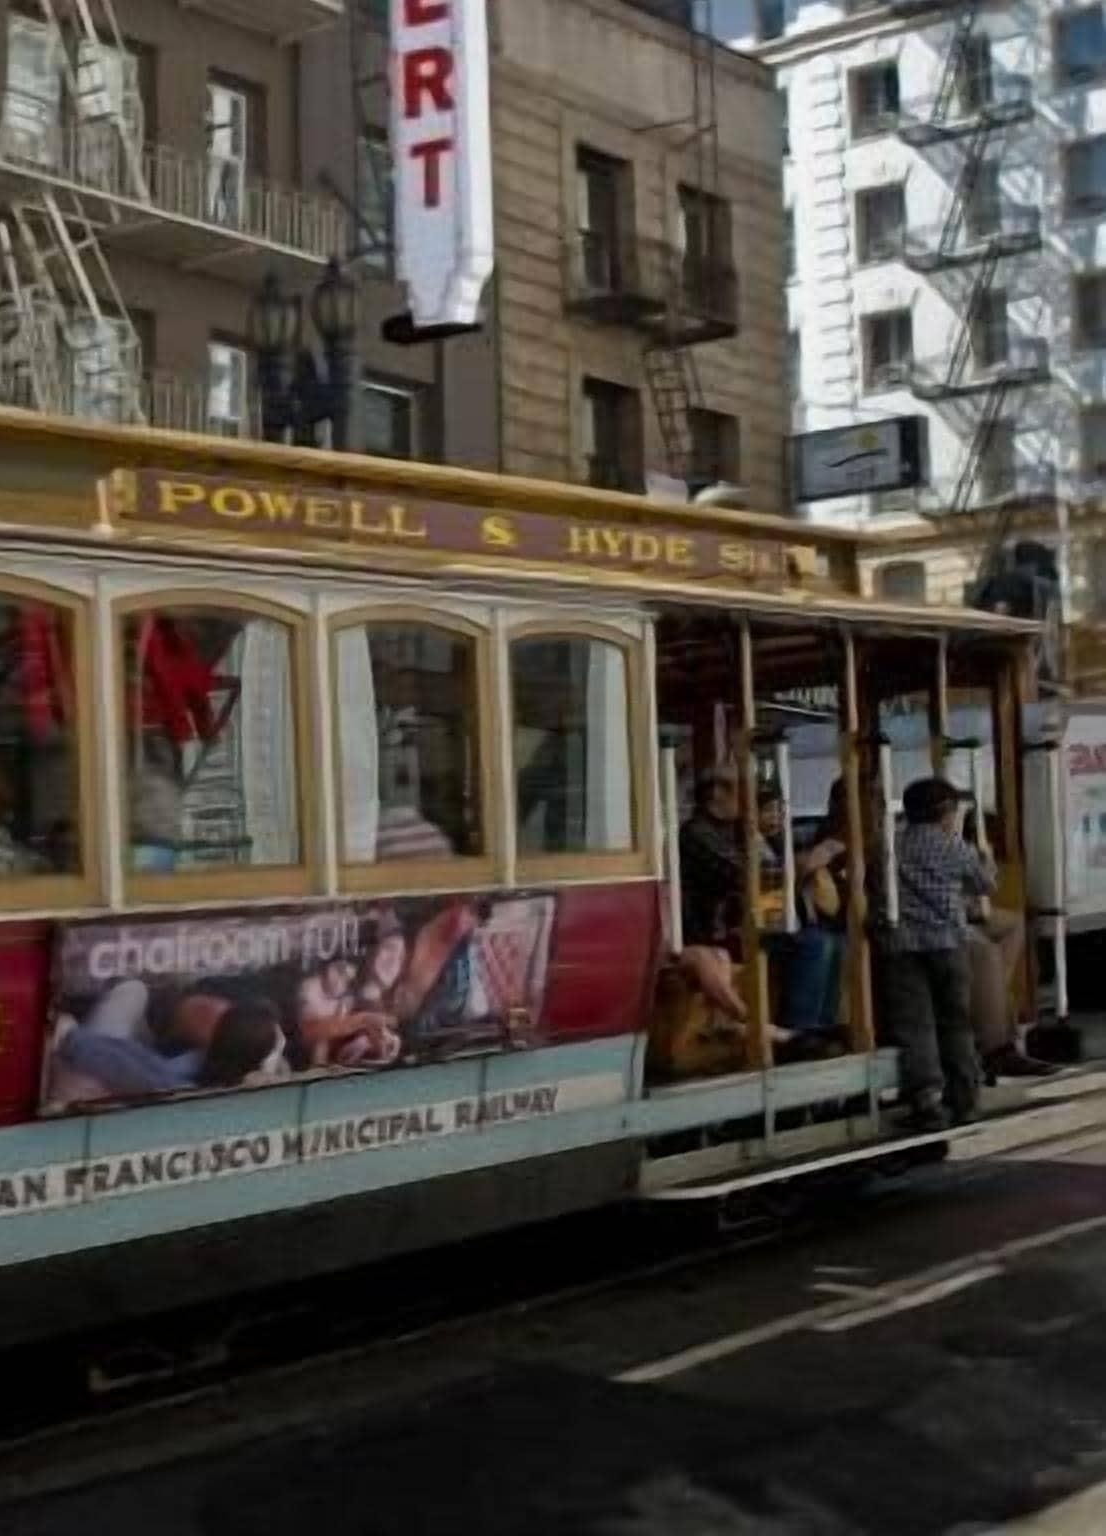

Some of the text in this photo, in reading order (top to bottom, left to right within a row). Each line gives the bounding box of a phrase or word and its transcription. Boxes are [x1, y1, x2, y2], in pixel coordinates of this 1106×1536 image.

[156, 479, 428, 538] POWELL
[567, 526, 699, 565] HYDE
[63, 1134, 271, 1198] FRANCISCO
[281, 1107, 444, 1158] MUNICIPAL
[453, 1085, 559, 1129] RAILWAY
